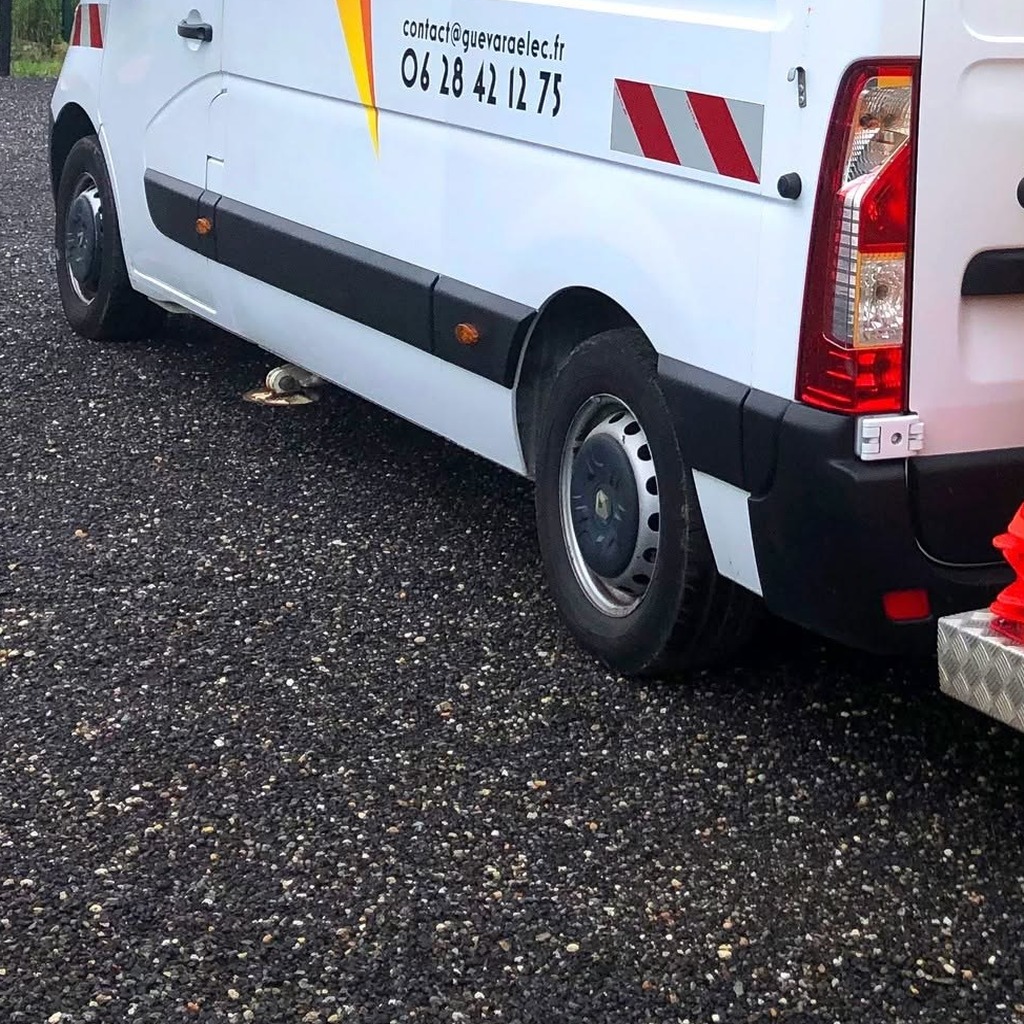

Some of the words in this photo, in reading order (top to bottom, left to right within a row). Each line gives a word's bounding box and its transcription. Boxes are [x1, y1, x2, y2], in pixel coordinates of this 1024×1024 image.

[403, 18, 565, 61] contact@guevaraelec.fr
[401, 47, 430, 92] 06
[439, 54, 463, 98] 28
[473, 59, 497, 106] 42
[508, 66, 527, 111] 12
[537, 70, 562, 117] 75
